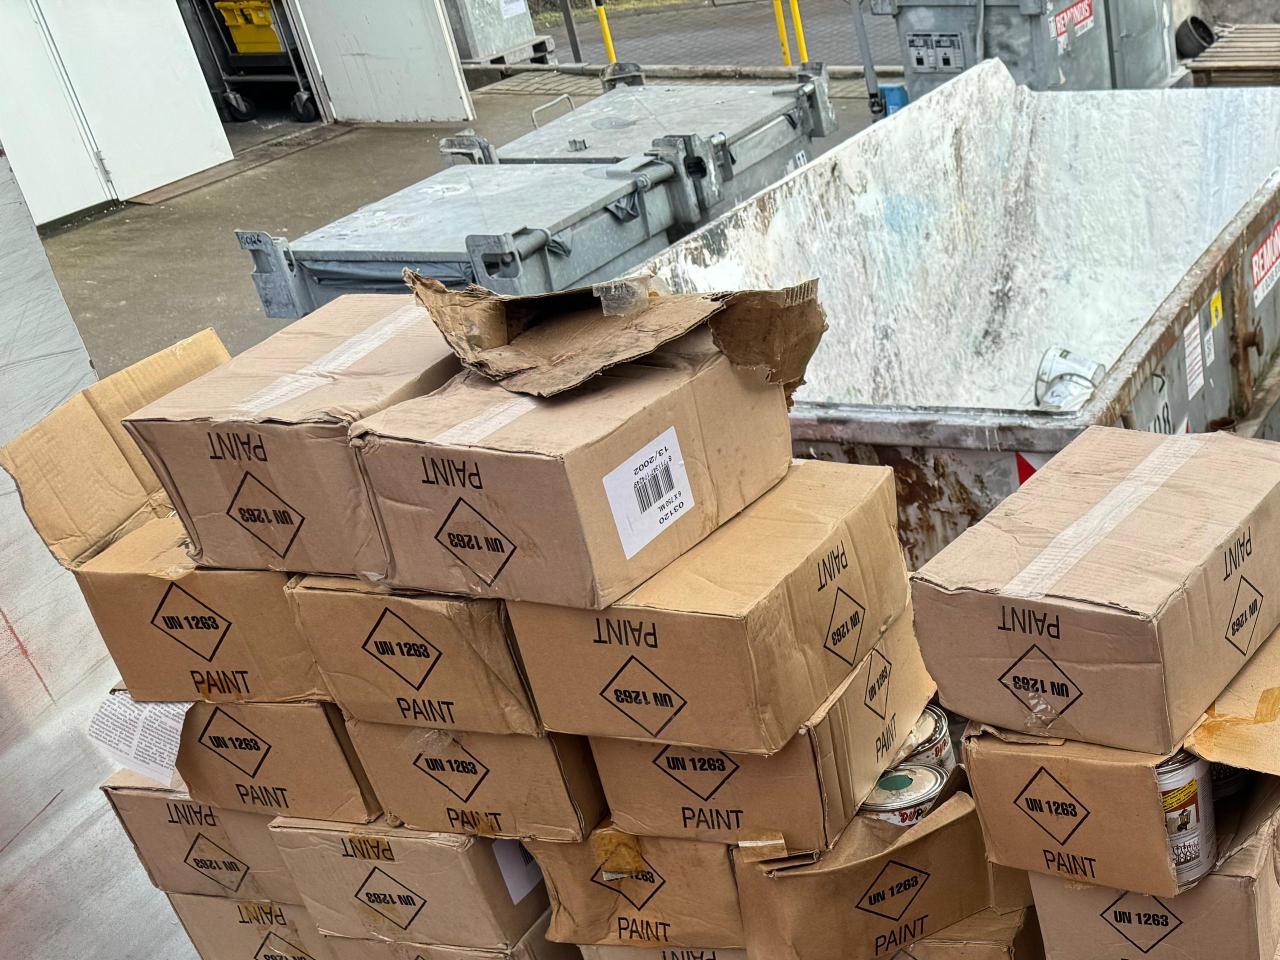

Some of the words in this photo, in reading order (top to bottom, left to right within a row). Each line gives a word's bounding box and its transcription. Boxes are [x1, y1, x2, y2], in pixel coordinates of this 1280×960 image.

[207, 431, 268, 461] PAINT
[634, 446, 669, 475] 13/2002
[421, 456, 483, 490] PAINT
[239, 507, 272, 524] 1263
[273, 509, 294, 526] UN
[659, 501, 684, 524] 03120
[448, 532, 483, 551] 1263
[484, 537, 504, 553] UN
[1224, 526, 1252, 581] PAINT
[817, 540, 848, 592] PAINT
[1248, 598, 1258, 618] UN
[162, 615, 182, 630] UN
[184, 616, 219, 630] 1263
[593, 618, 658, 648] PAINT
[832, 620, 851, 646] 1263
[998, 605, 1061, 640] PAINT
[1232, 610, 1248, 636] 1263
[374, 641, 394, 656] UN
[396, 642, 430, 658] 1263
[190, 670, 250, 694] PAINT
[1012, 675, 1048, 692] 1263
[1051, 681, 1070, 698] UN
[614, 688, 651, 706] 1263
[654, 693, 674, 708] UN
[396, 698, 456, 724] PAINT
[209, 736, 228, 749] UN
[230, 737, 260, 752] 1263
[876, 713, 897, 763] PAINT
[424, 758, 443, 772] UN
[446, 760, 478, 775] 1263
[666, 756, 686, 771] UN
[692, 757, 726, 772] 1263
[235, 784, 290, 809] PAINT
[1025, 797, 1044, 814] UN
[1044, 799, 1078, 818] 1263
[166, 802, 217, 826] PAINT
[681, 807, 744, 830] PAINT
[341, 838, 395, 861] PAINT
[1043, 849, 1096, 878] PAINT
[366, 892, 396, 906] 1263
[868, 890, 886, 906] UN
[888, 875, 920, 898] 1263
[238, 904, 287, 926] PAINT
[1113, 910, 1132, 925] UN
[1136, 912, 1169, 928] 1263
[617, 916, 671, 942] PAINT
[874, 914, 929, 956] PAINT
